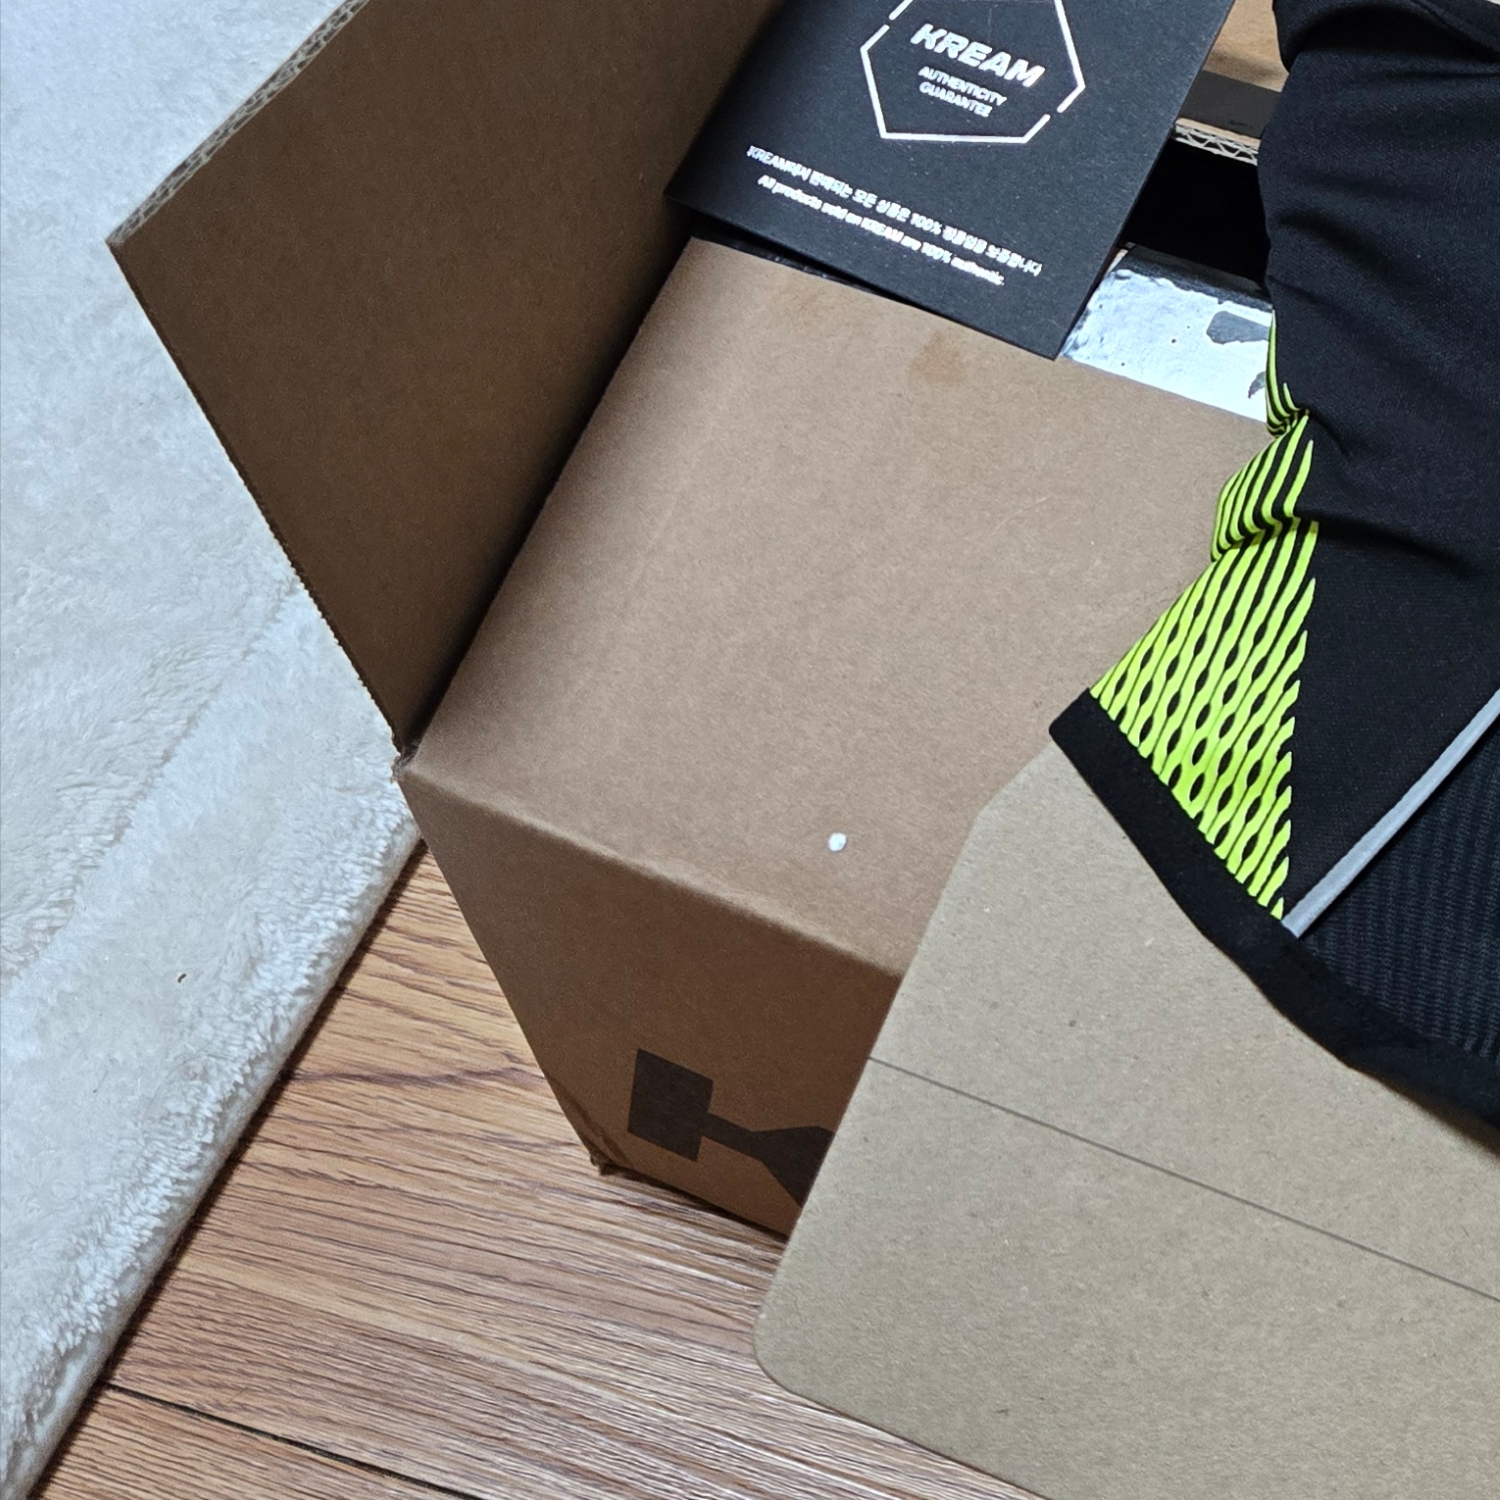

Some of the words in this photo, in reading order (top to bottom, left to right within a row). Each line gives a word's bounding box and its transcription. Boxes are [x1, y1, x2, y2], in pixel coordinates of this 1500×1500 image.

[909, 23, 1046, 88] KREAM
[918, 66, 1008, 107] AUTHENTICITY
[919, 81, 993, 118] GUARANTEE
[757, 174, 777, 190] All
[771, 182, 823, 210] products
[821, 202, 849, 220] sold
[845, 212, 863, 226] on
[860, 217, 905, 243] KREAM
[900, 235, 922, 251] are
[920, 242, 953, 263] 100%
[852, 188, 878, 208] 모든
[910, 212, 943, 235] 100%
